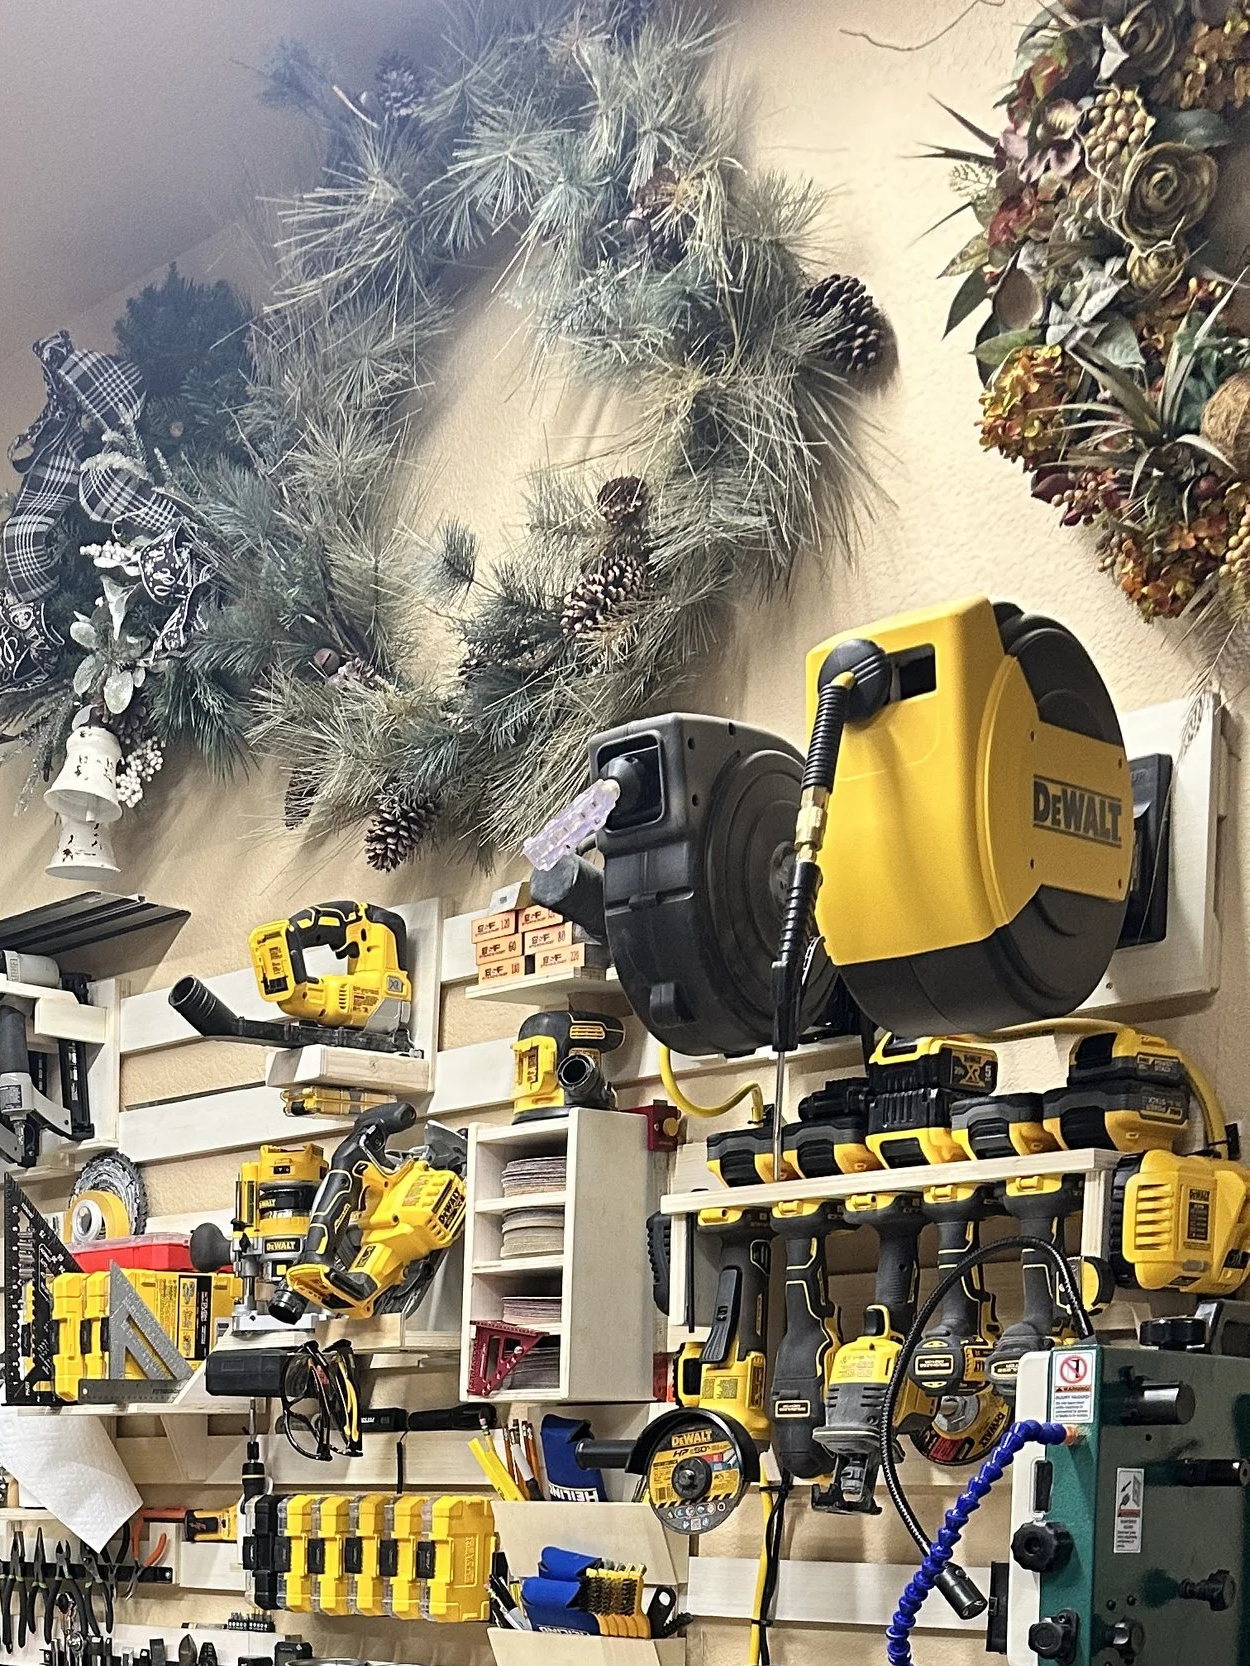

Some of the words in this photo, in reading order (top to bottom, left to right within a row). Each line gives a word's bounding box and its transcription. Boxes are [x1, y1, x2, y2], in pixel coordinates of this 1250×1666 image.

[1033, 780, 1122, 842] DEWALT
[266, 1241, 296, 1251] DEWALT
[672, 1429, 712, 1447] DEWALT
